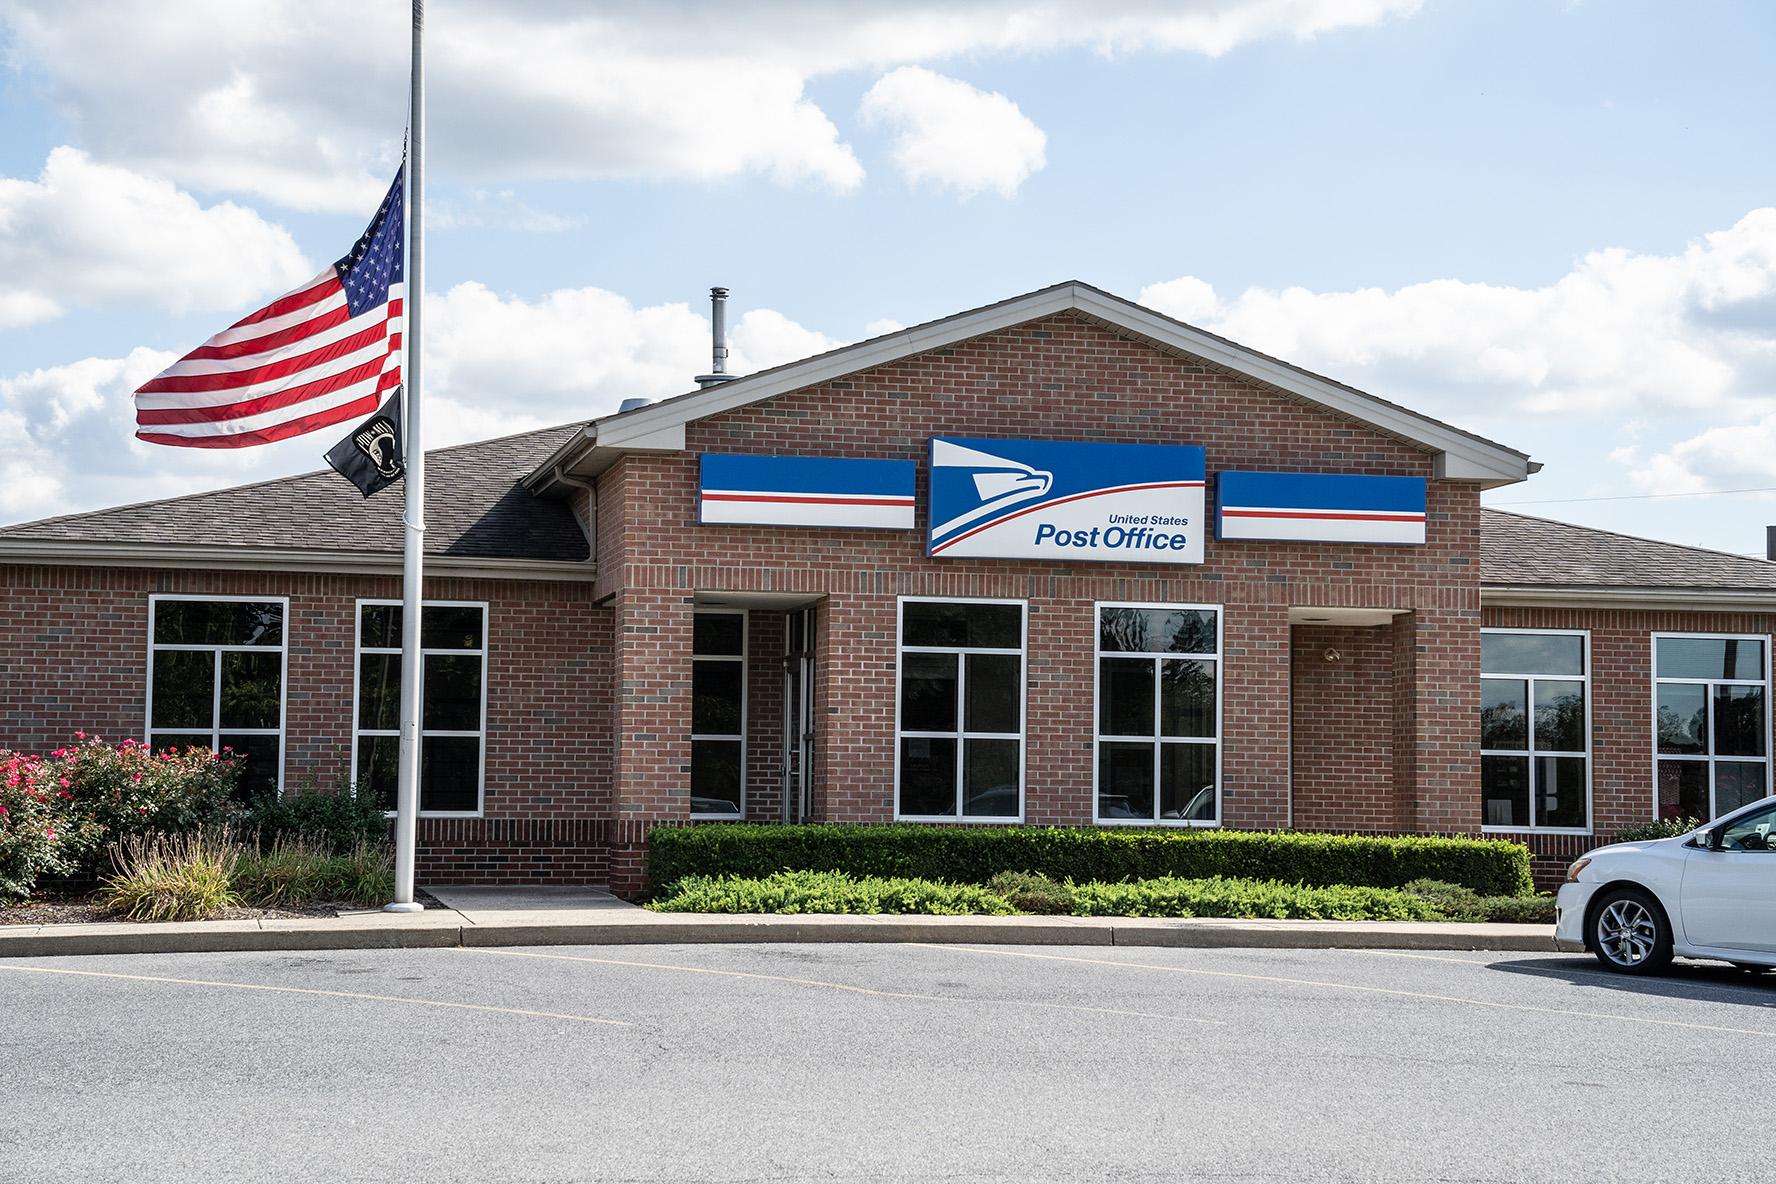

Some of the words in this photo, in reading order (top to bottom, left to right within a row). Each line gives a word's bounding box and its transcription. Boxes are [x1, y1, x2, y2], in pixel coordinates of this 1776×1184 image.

[1109, 514, 1148, 524] United
[1150, 515, 1188, 526] States
[1035, 523, 1100, 547] Post
[1103, 526, 1186, 550] Office
